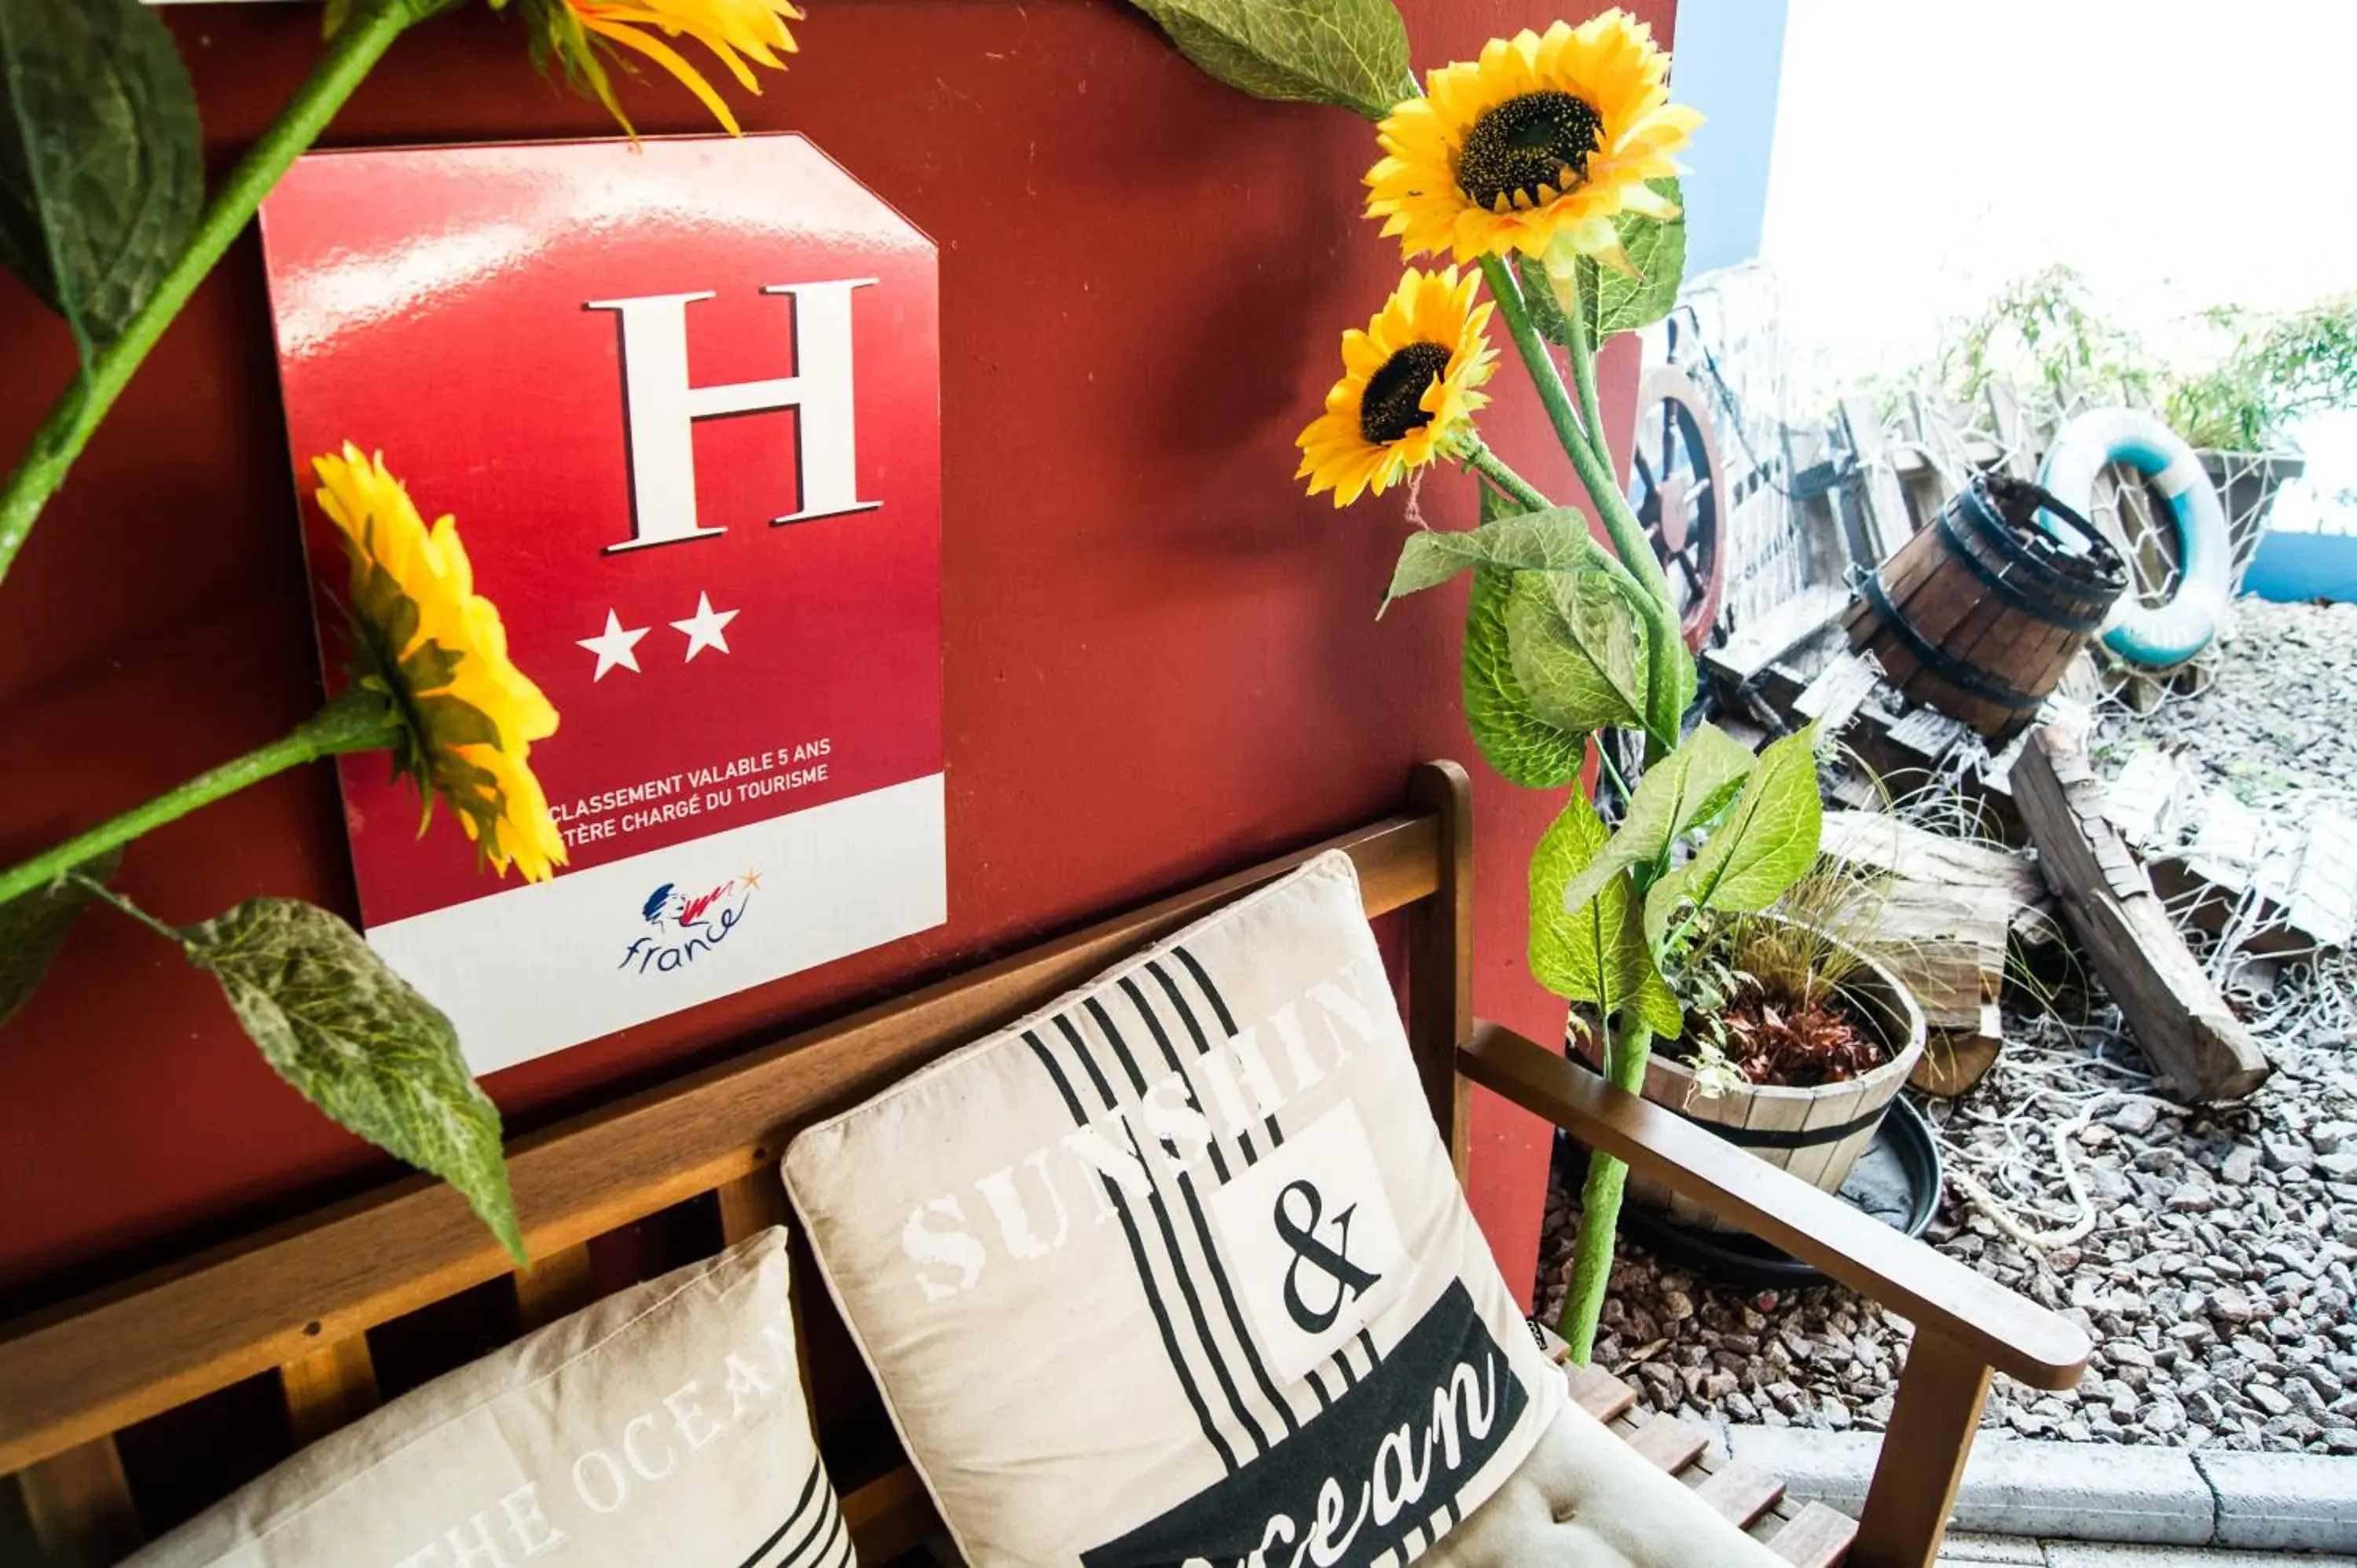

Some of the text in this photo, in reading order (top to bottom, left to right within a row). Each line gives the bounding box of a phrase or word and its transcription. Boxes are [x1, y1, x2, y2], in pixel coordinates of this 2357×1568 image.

[581, 277, 884, 557] H
[548, 738, 831, 823] CLASSEMENT VALABLE 5 ANS
[559, 764, 830, 848] TÈRE CHARGÉ DU TOURISME
[618, 891, 750, 975] france
[1274, 1179, 1382, 1335] &
[1178, 1352, 1494, 1568] cean
